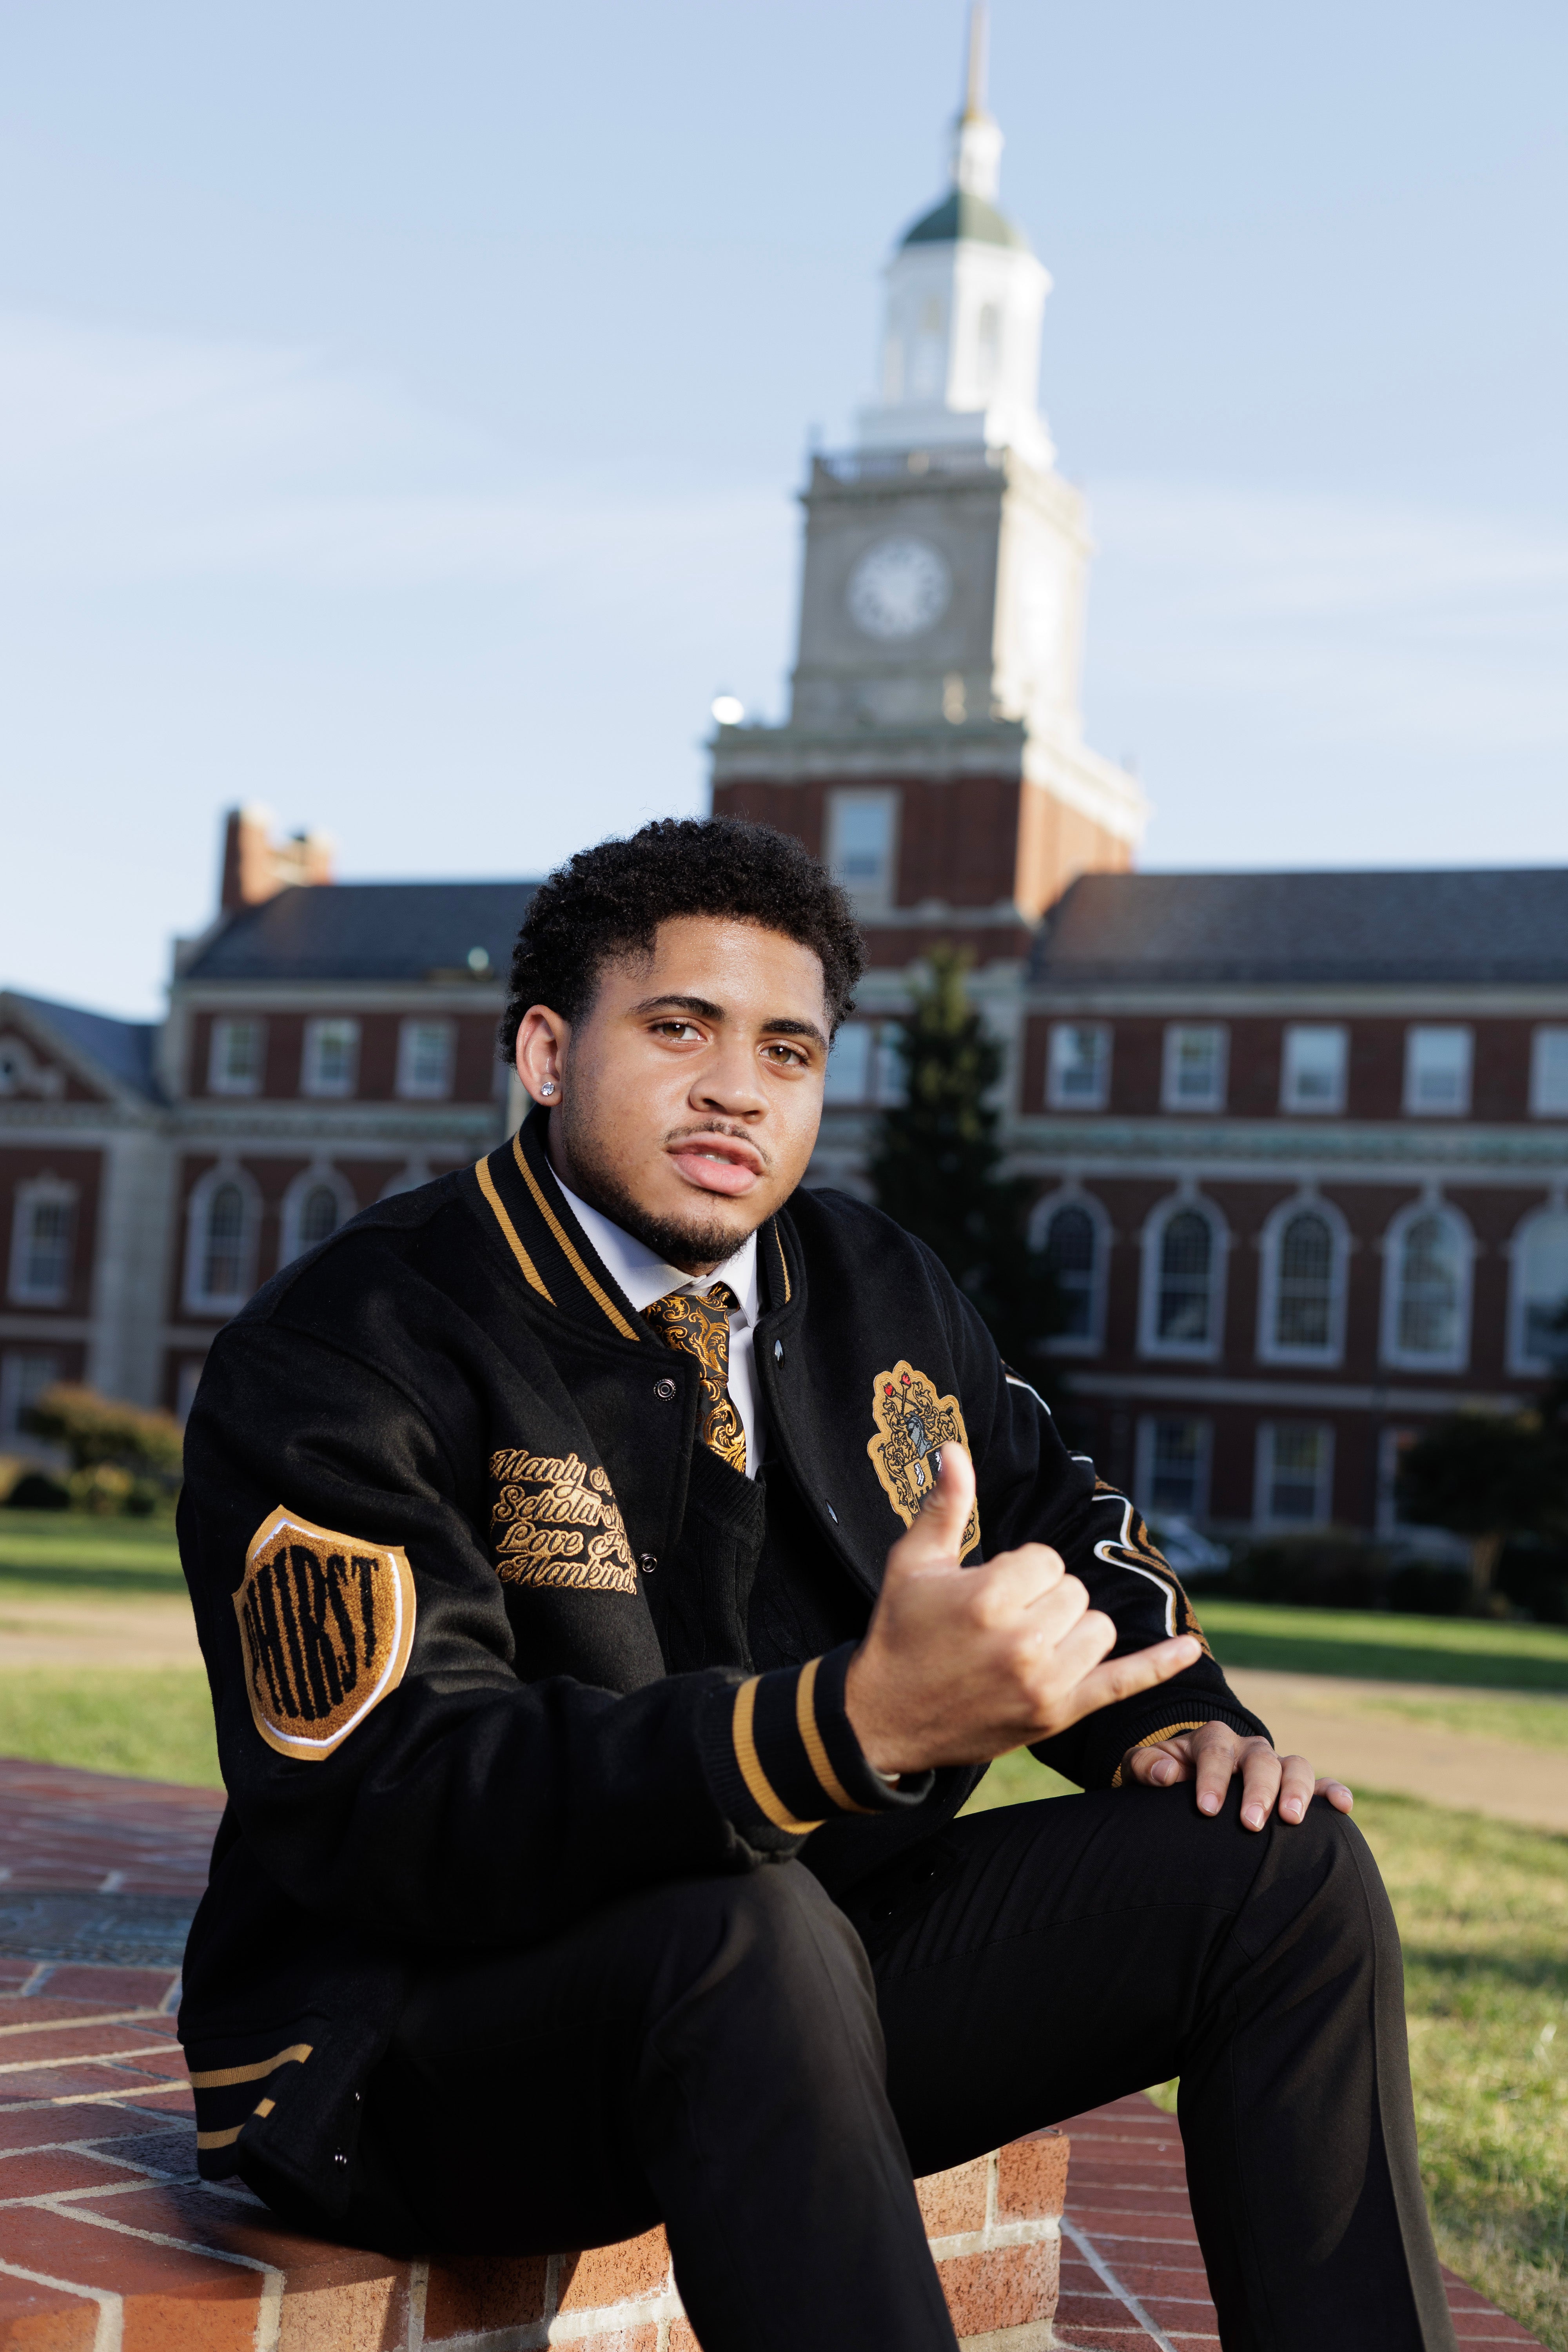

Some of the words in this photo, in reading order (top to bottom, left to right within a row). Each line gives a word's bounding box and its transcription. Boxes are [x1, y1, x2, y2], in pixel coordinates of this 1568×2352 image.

[489, 1449, 600, 1499] Manly
[493, 1485, 625, 1531] Scholarsh
[497, 1523, 583, 1555] Love
[497, 1555, 636, 1593] Mankind
